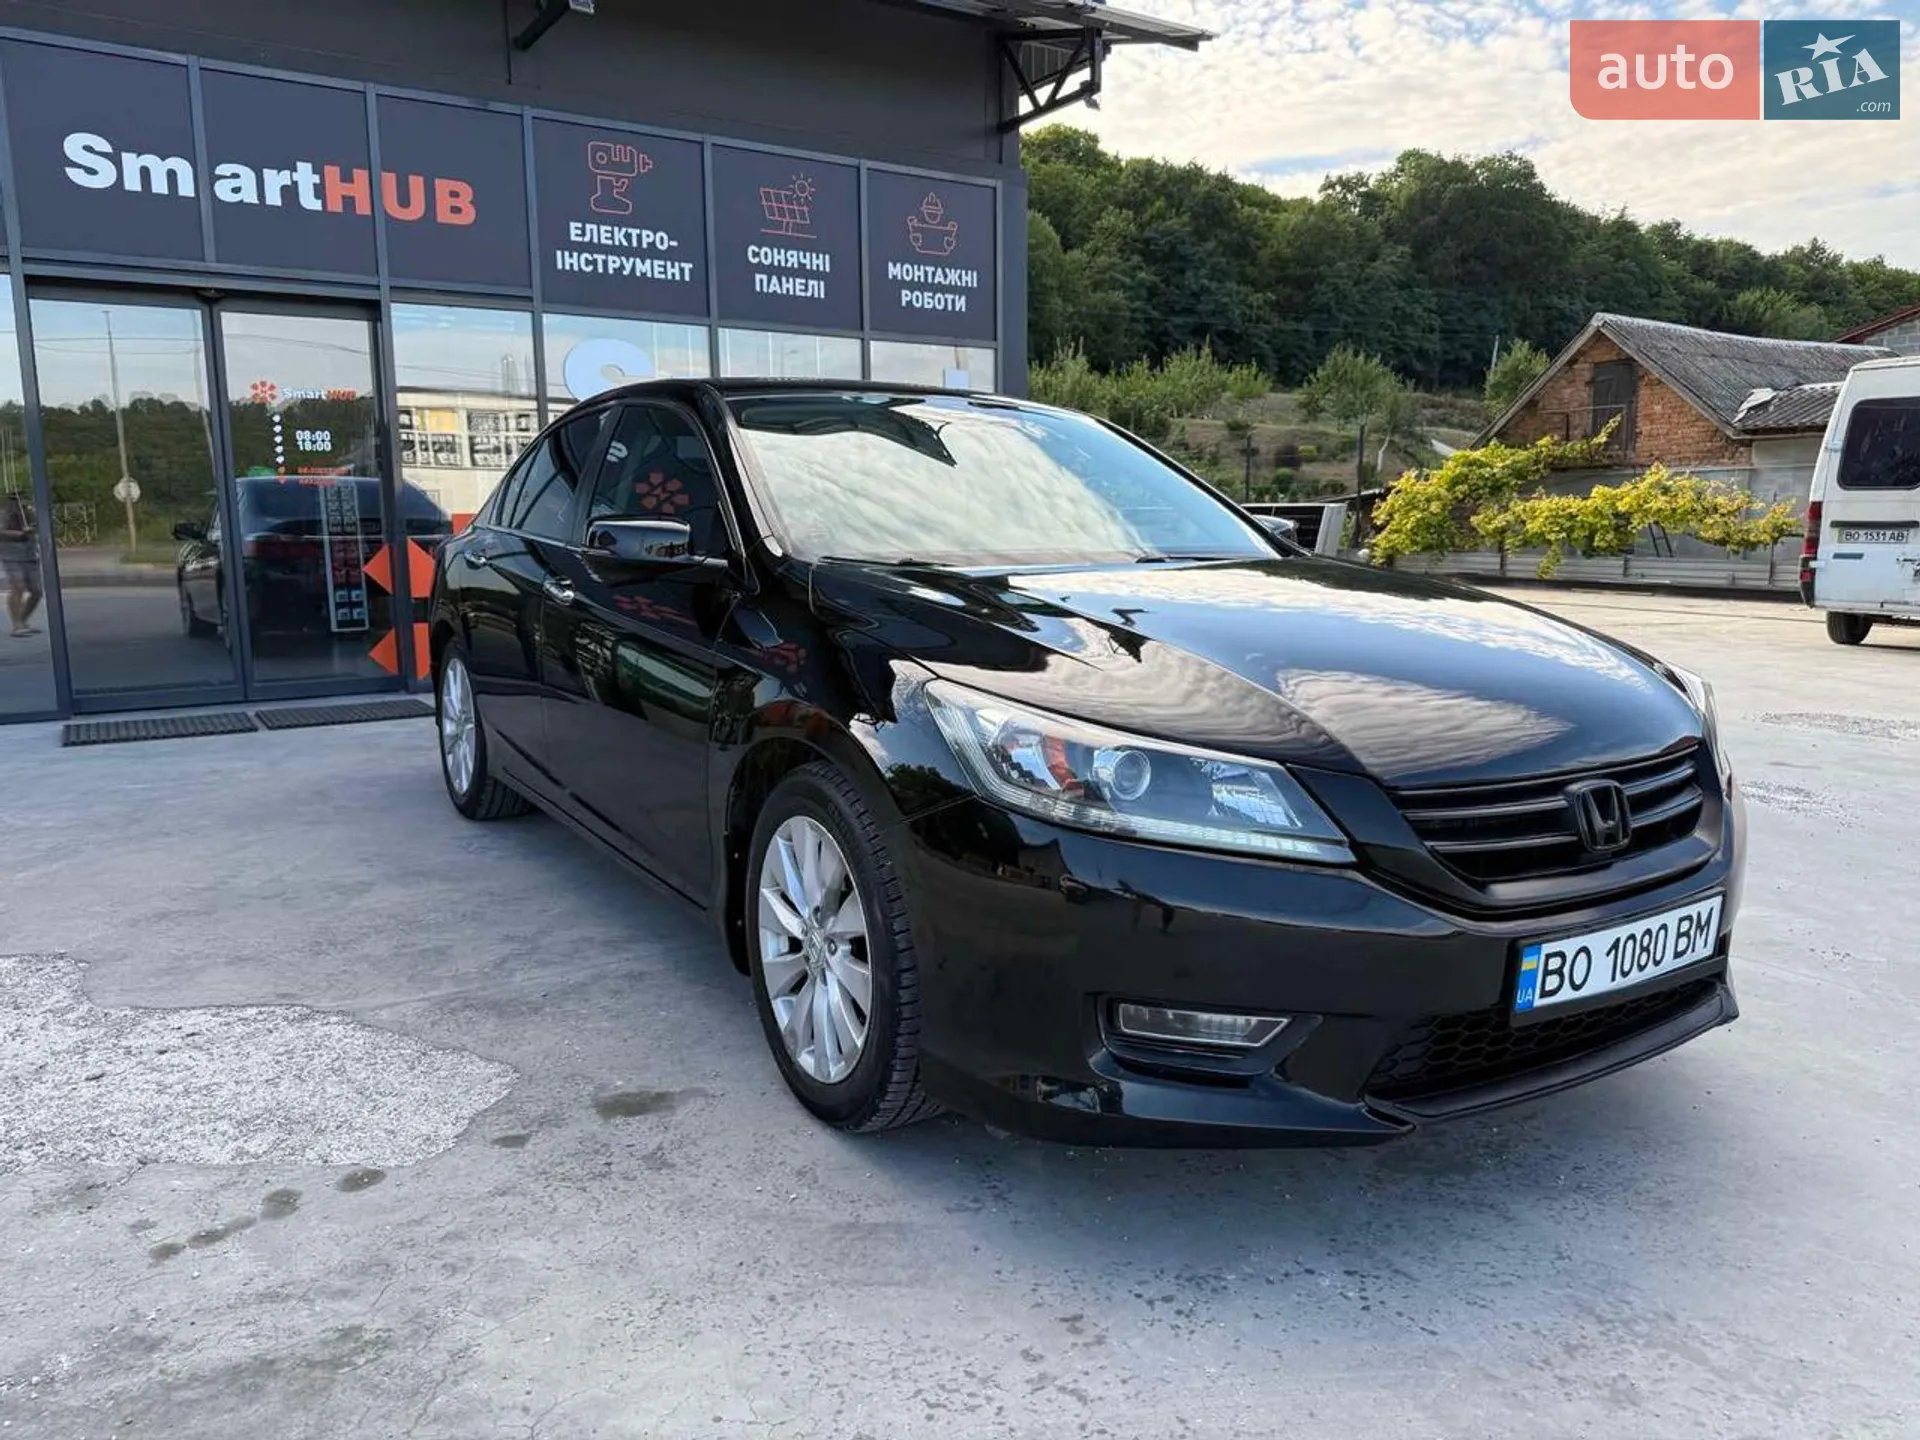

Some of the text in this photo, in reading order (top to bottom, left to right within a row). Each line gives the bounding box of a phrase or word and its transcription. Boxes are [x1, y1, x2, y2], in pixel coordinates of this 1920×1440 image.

[568, 221, 678, 251] ЕЛЕКТРО-
[556, 250, 693, 283] ІНСТРУМЕНТ
[747, 244, 830, 273] СОНЯЧНІ
[755, 273, 825, 299] ПАНЕЛІ
[887, 261, 978, 289] МОНТАЖНІ
[901, 288, 967, 313] РОБОТИ
[295, 430, 331, 441] 08:00
[1539, 907, 1715, 999] BO 1080 BM
[1517, 986, 1533, 1003] UA
